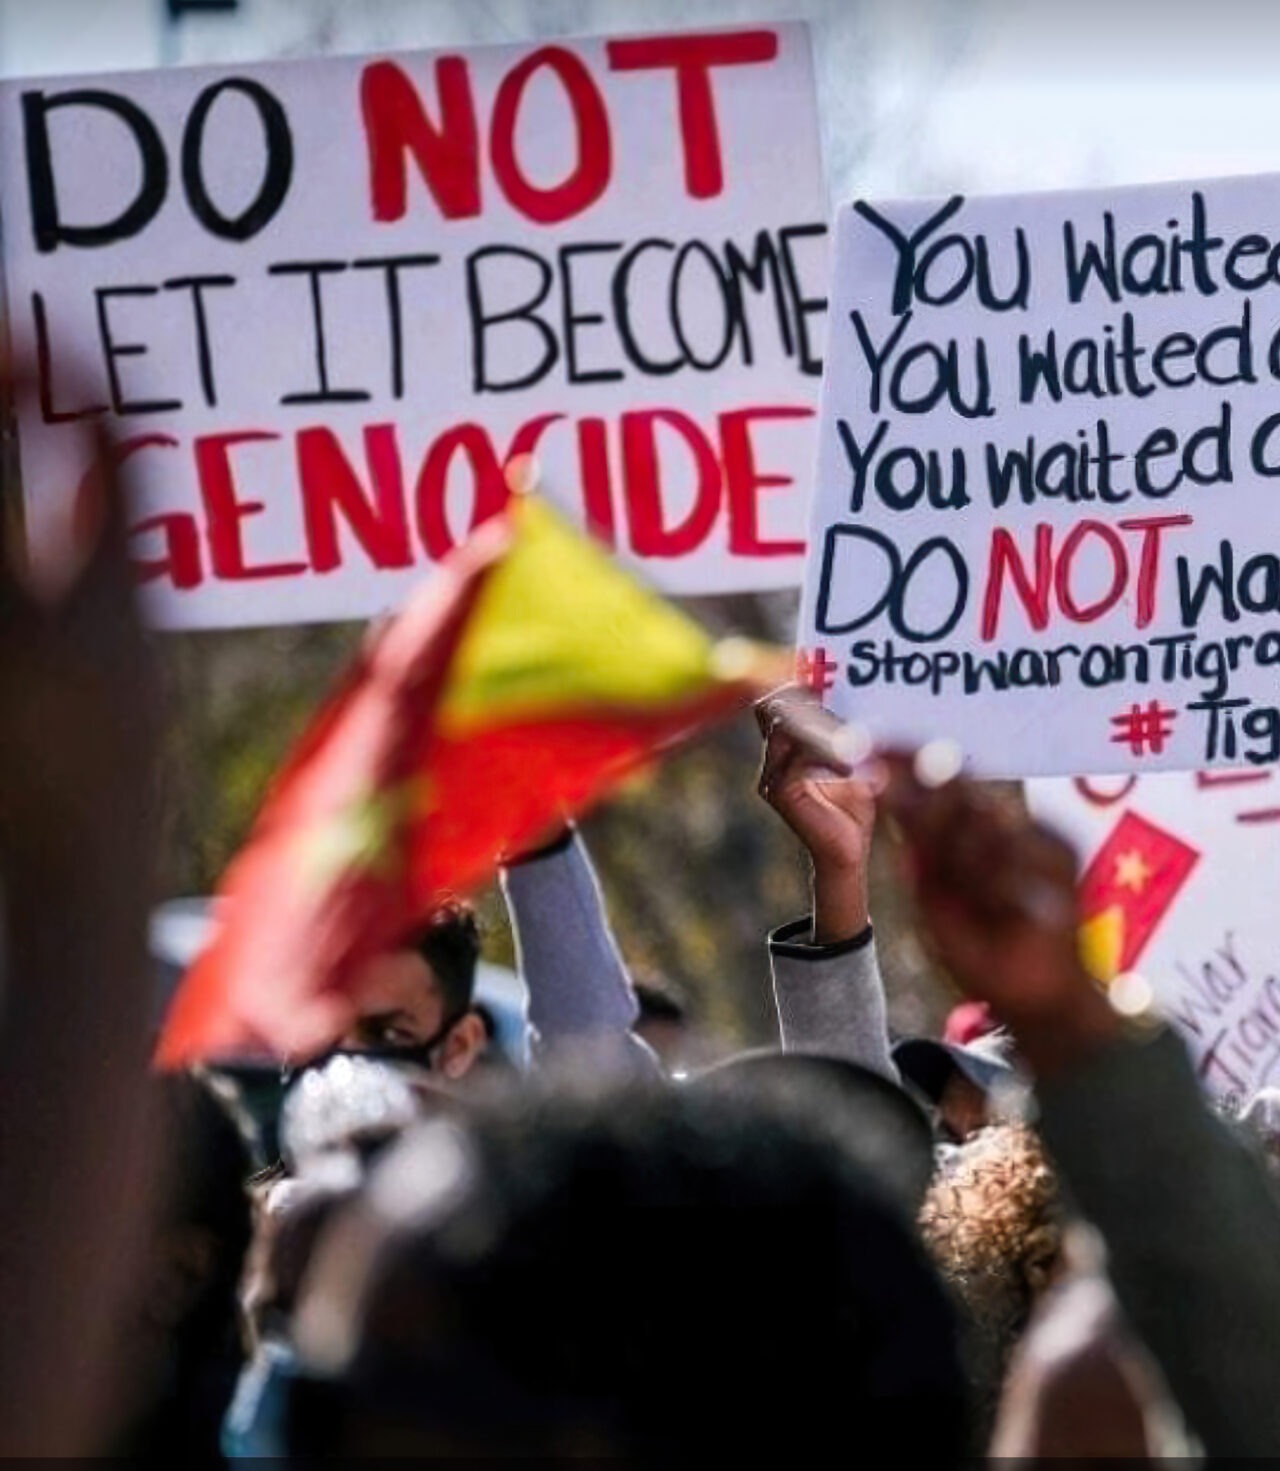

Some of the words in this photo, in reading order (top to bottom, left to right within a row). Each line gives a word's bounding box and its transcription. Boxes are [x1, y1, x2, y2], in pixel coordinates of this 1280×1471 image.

[21, 77, 294, 254] DO
[359, 30, 778, 225] NOT
[32, 275, 237, 424] LET
[268, 254, 441, 405] IT
[466, 223, 828, 394] BECOME
[815, 523, 969, 643] DO
[981, 514, 1193, 642] NOT
